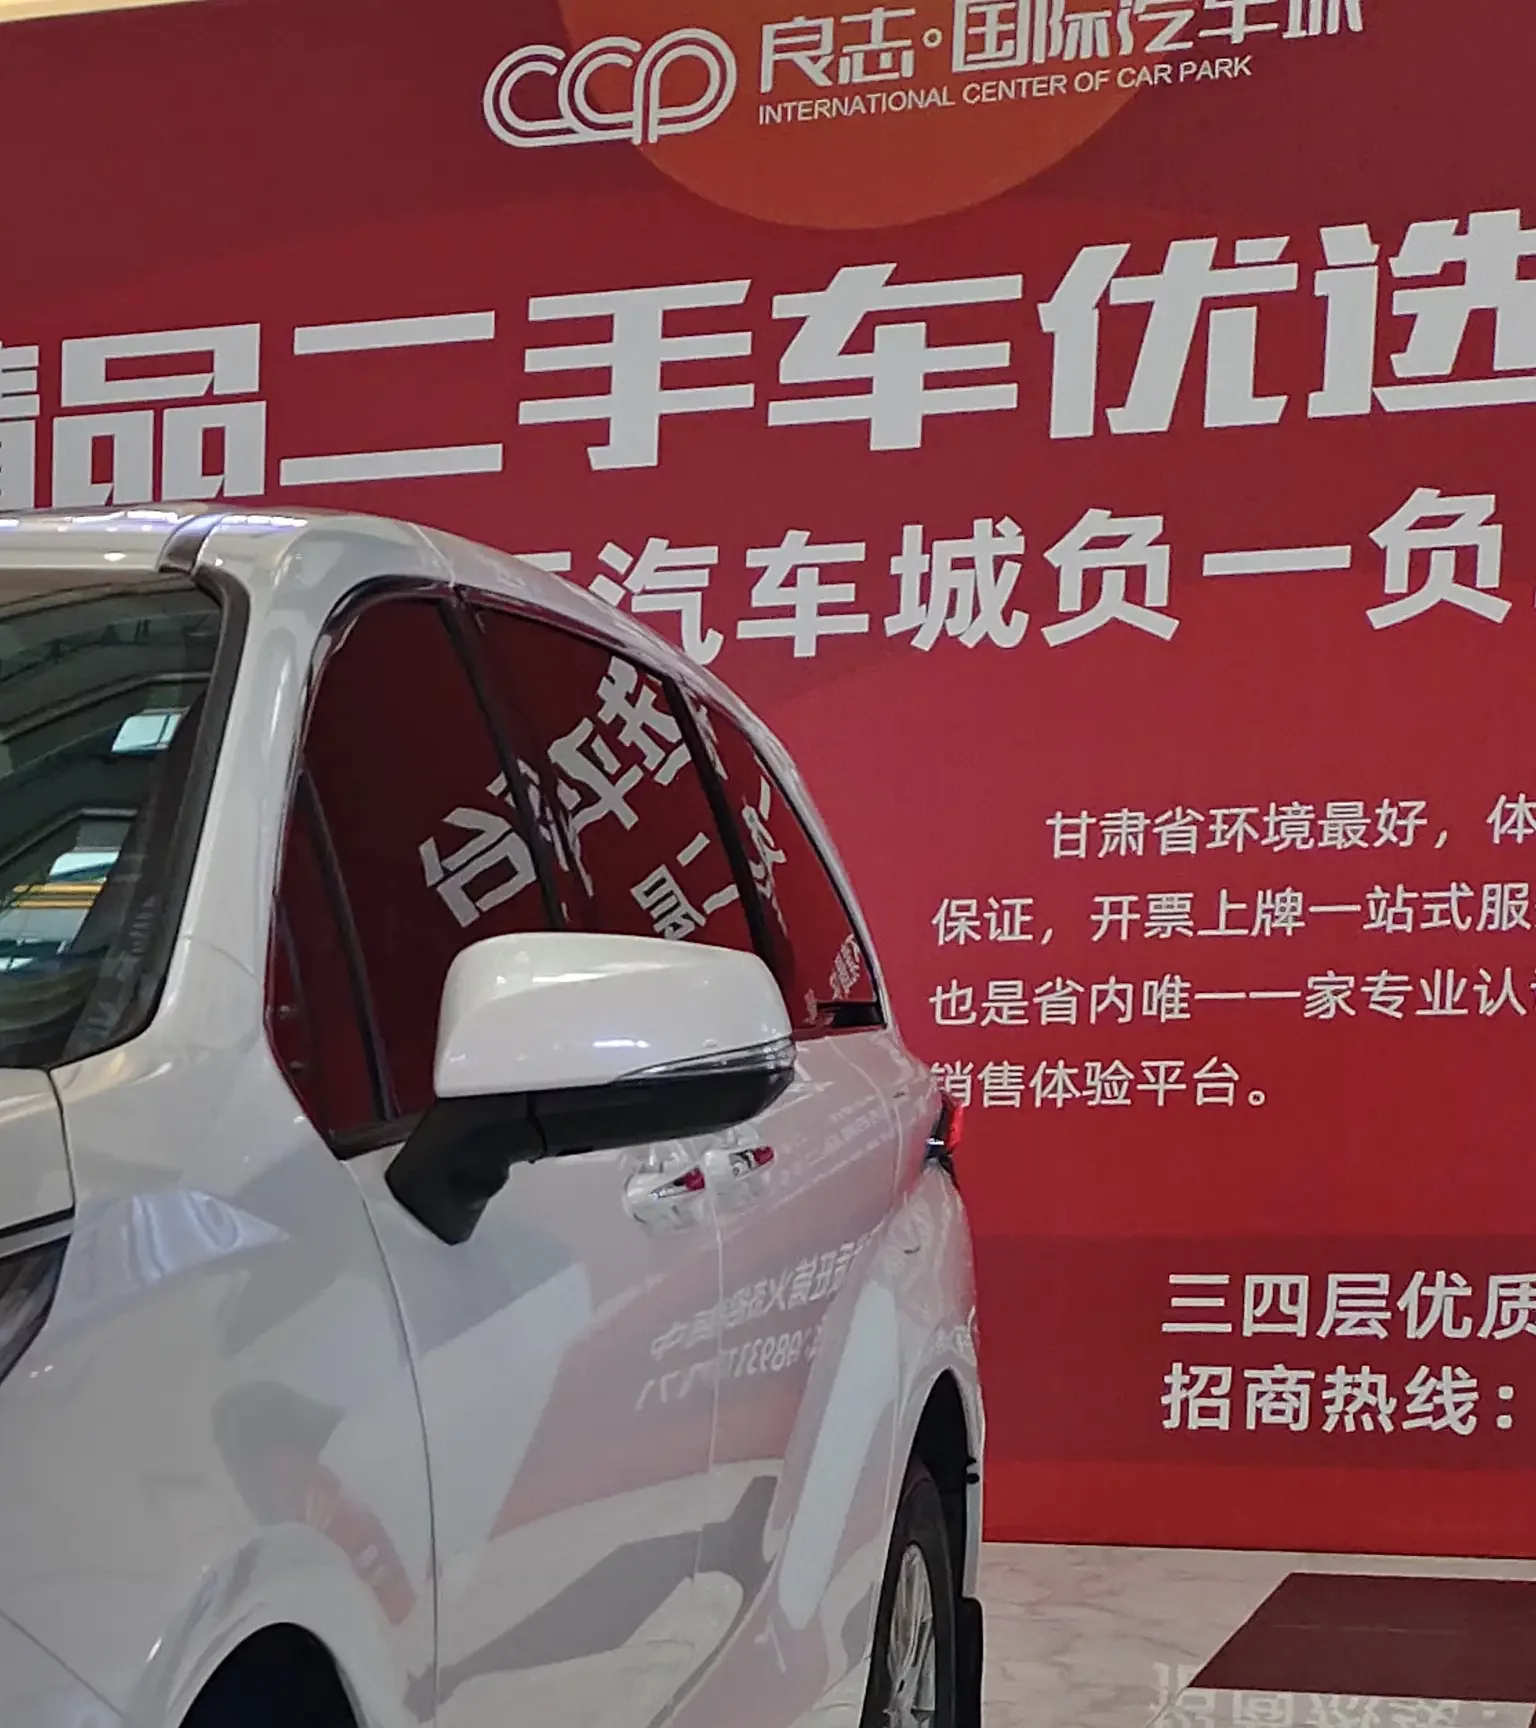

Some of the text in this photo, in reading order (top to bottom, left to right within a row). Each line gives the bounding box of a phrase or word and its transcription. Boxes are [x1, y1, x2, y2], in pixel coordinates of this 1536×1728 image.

[758, 55, 1254, 126] INTERNATIONAL CENTER OF CAR PARK
